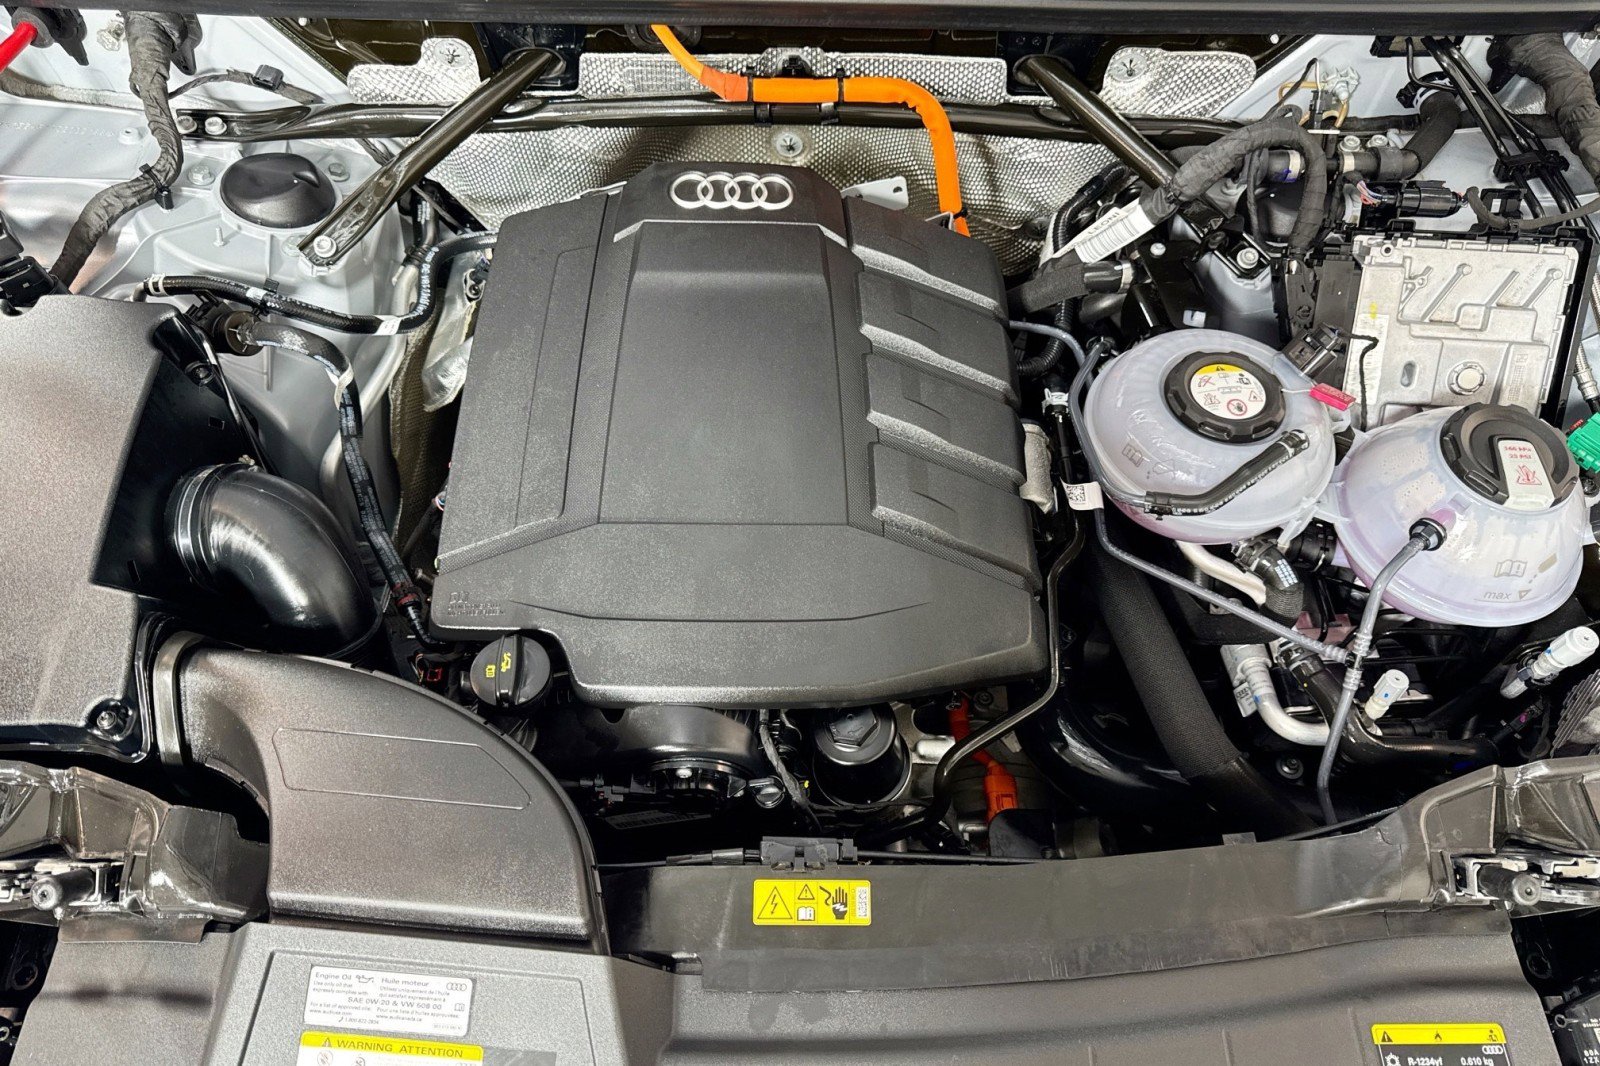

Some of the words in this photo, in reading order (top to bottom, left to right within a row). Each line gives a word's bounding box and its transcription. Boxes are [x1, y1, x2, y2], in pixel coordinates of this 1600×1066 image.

[1088, 211, 1120, 235] LEONI
[1483, 591, 1512, 600] max
[315, 972, 340, 980] Engine
[381, 977, 400, 985] Huile
[337, 1039, 393, 1052] WARNING
[399, 1045, 464, 1058] ATTENTION
[1483, 1057, 1494, 1066] kg
